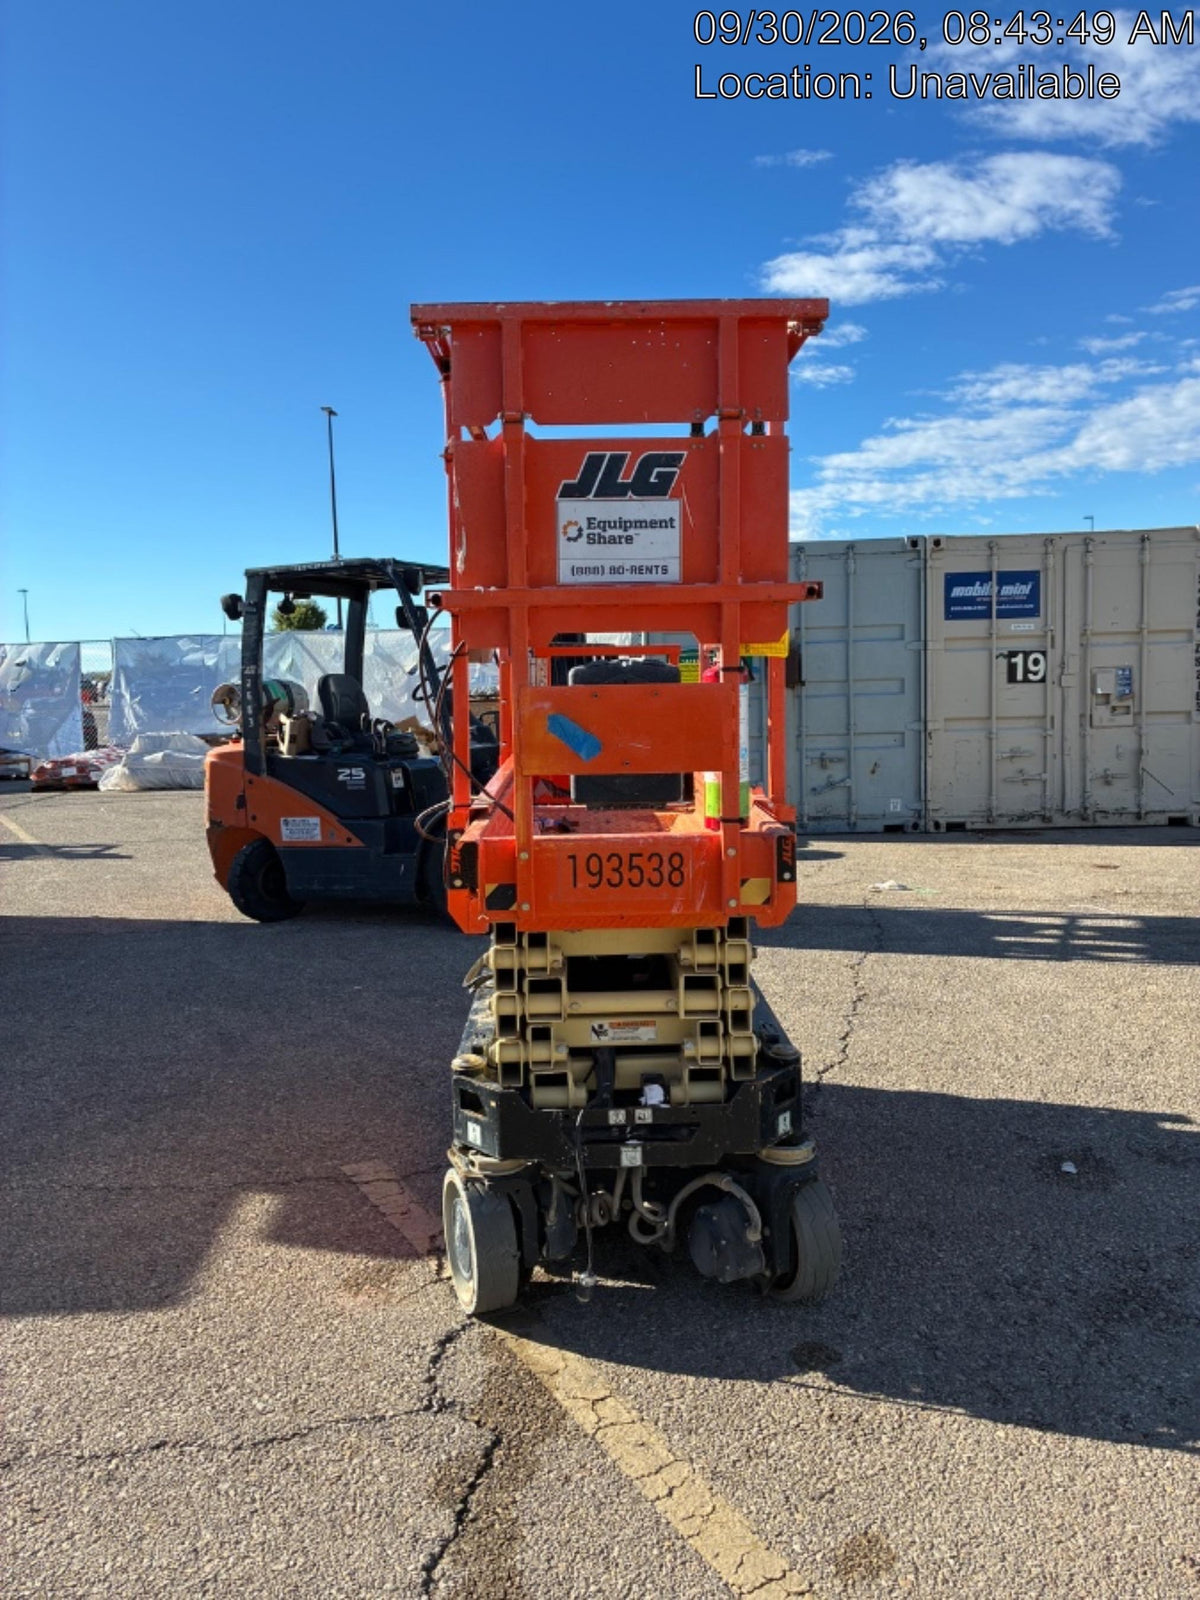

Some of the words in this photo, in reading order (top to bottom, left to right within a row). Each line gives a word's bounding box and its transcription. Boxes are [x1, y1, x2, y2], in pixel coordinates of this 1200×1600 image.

[555, 451, 687, 499] JLG
[586, 517, 676, 532] Equipment
[1000, 582, 1033, 596] mini
[1011, 652, 1046, 682] 19
[337, 767, 366, 781] 25
[568, 852, 685, 889] 193538
